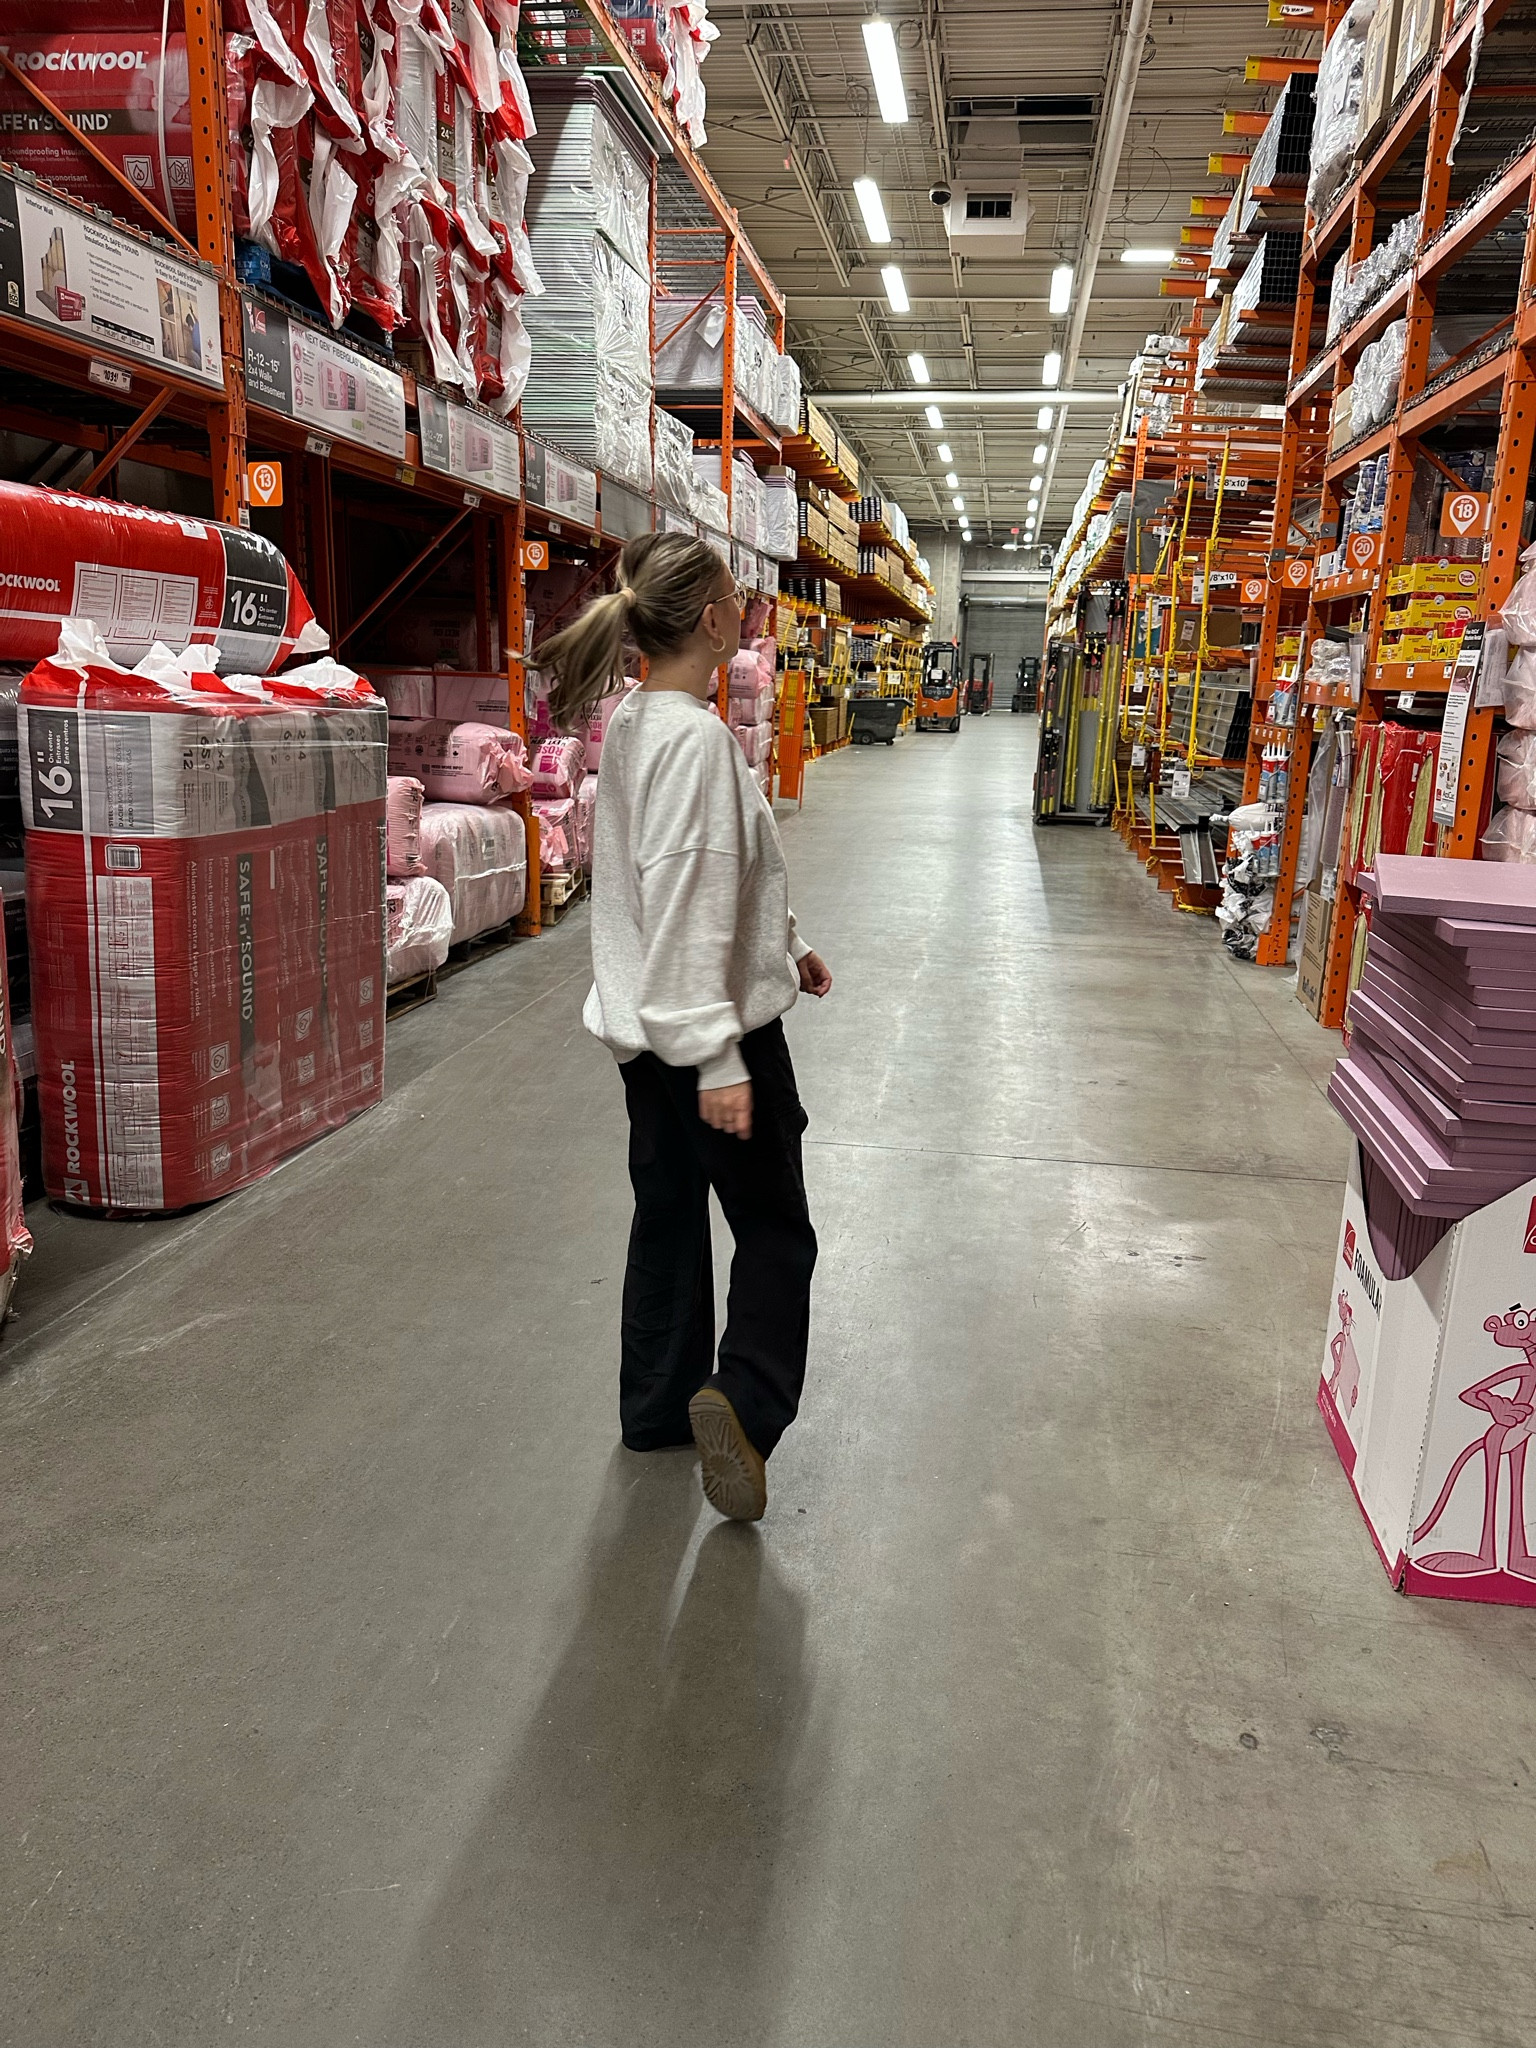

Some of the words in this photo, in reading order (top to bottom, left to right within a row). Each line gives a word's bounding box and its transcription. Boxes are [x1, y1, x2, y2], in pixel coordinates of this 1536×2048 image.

[14, 51, 147, 71] ROCKWOOL
[258, 368, 273, 383] Walls
[247, 378, 260, 390] and
[259, 382, 286, 401] Basement
[259, 473, 272, 488] 13
[1456, 503, 1473, 519] 18
[531, 547, 541, 559] 15
[1356, 542, 1370, 554] 20
[1290, 567, 1303, 577] 22
[1248, 585, 1259, 593] 24
[230, 590, 268, 626] 16"
[535, 745, 564, 755] ROSE
[183, 749, 194, 770] 12
[37, 751, 74, 819] 16"
[209, 932, 215, 942] et
[61, 1060, 81, 1175] ROCKWOOL
